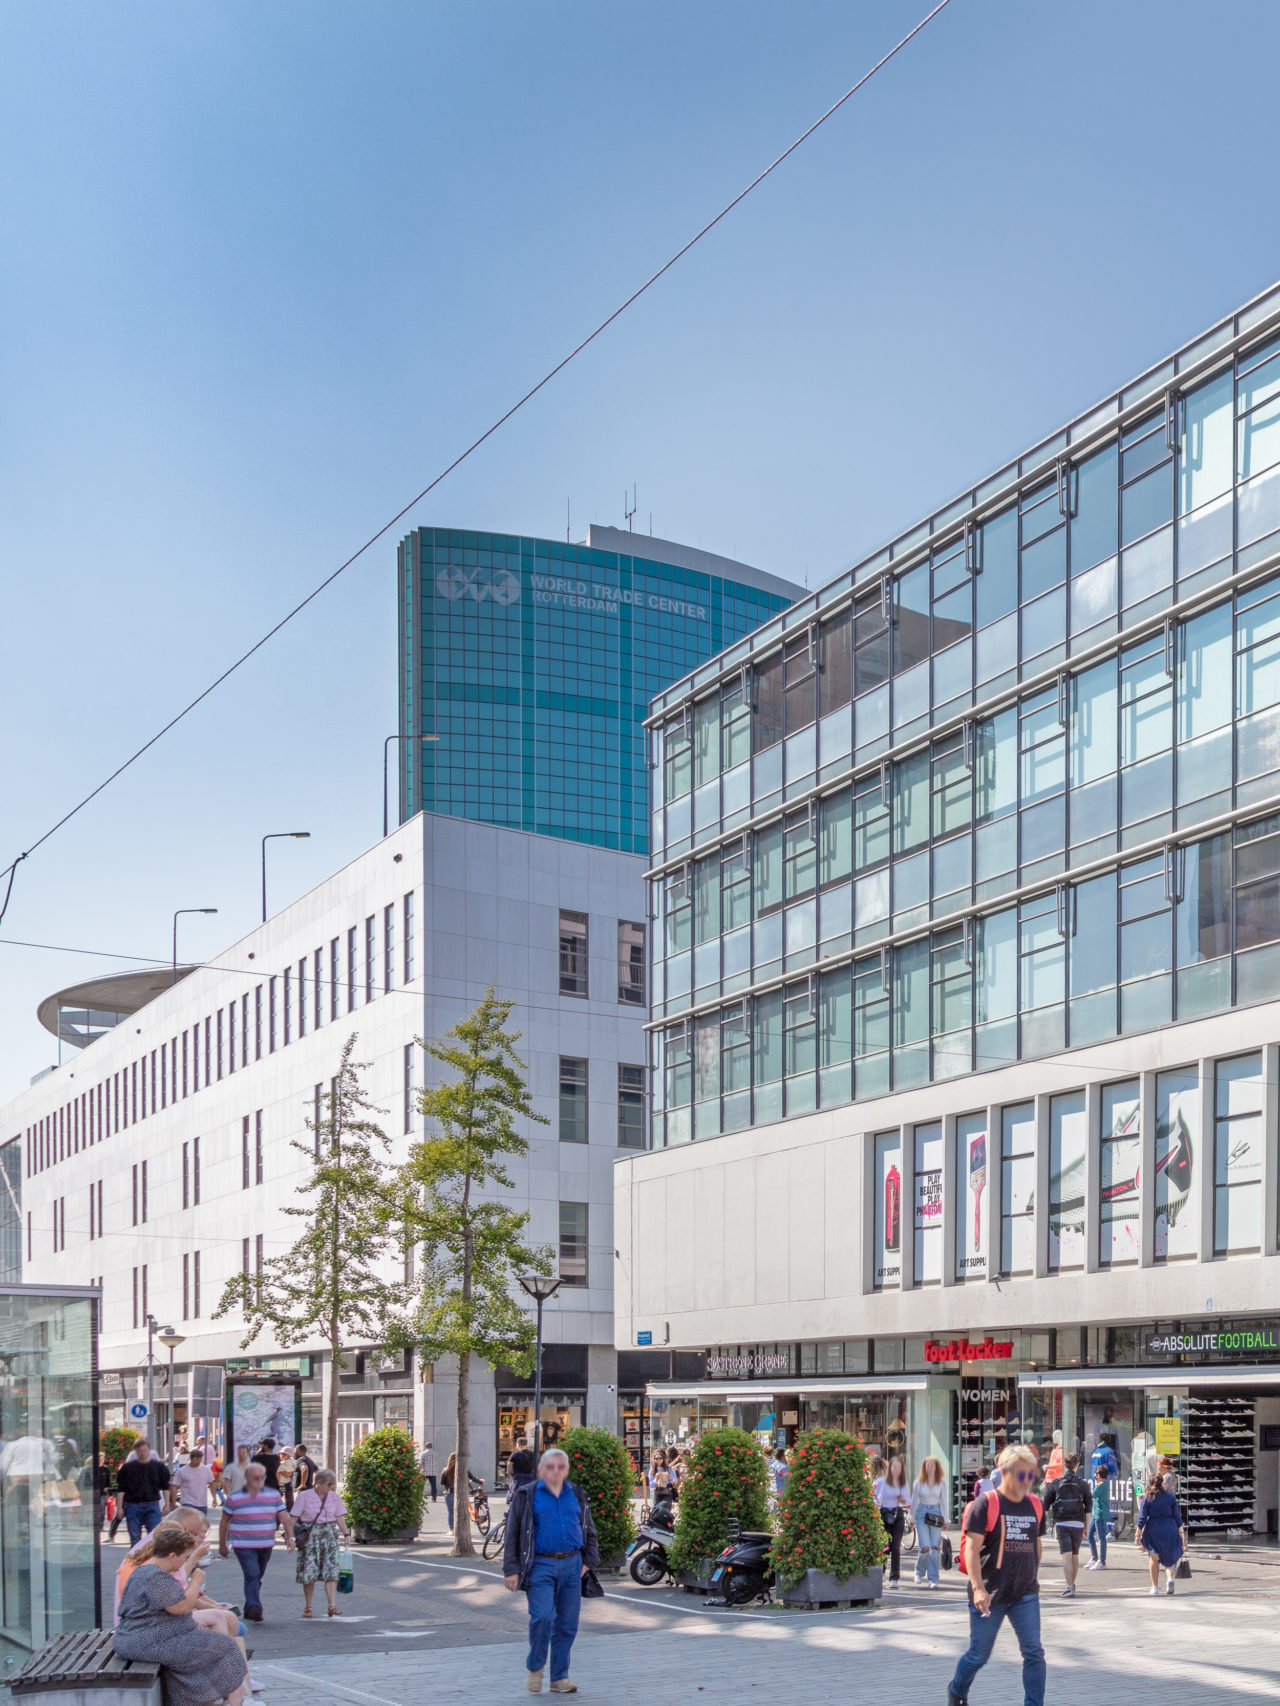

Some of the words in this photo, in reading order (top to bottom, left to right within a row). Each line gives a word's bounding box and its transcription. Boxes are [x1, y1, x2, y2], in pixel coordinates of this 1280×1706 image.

[530, 574, 587, 595] WORLD
[592, 584, 643, 606] TRADE
[648, 595, 706, 620] CENTER
[533, 590, 618, 614] ROTTERDAM
[928, 1175, 941, 1185] PLAY
[928, 1194, 940, 1204] PLAY
[960, 1258, 969, 1268] ART
[878, 1268, 886, 1277] ART
[924, 1340, 958, 1361] Foot
[959, 1337, 1014, 1360] Locker
[754, 1353, 788, 1374] GRENE
[957, 1389, 1010, 1402] WOMEN
